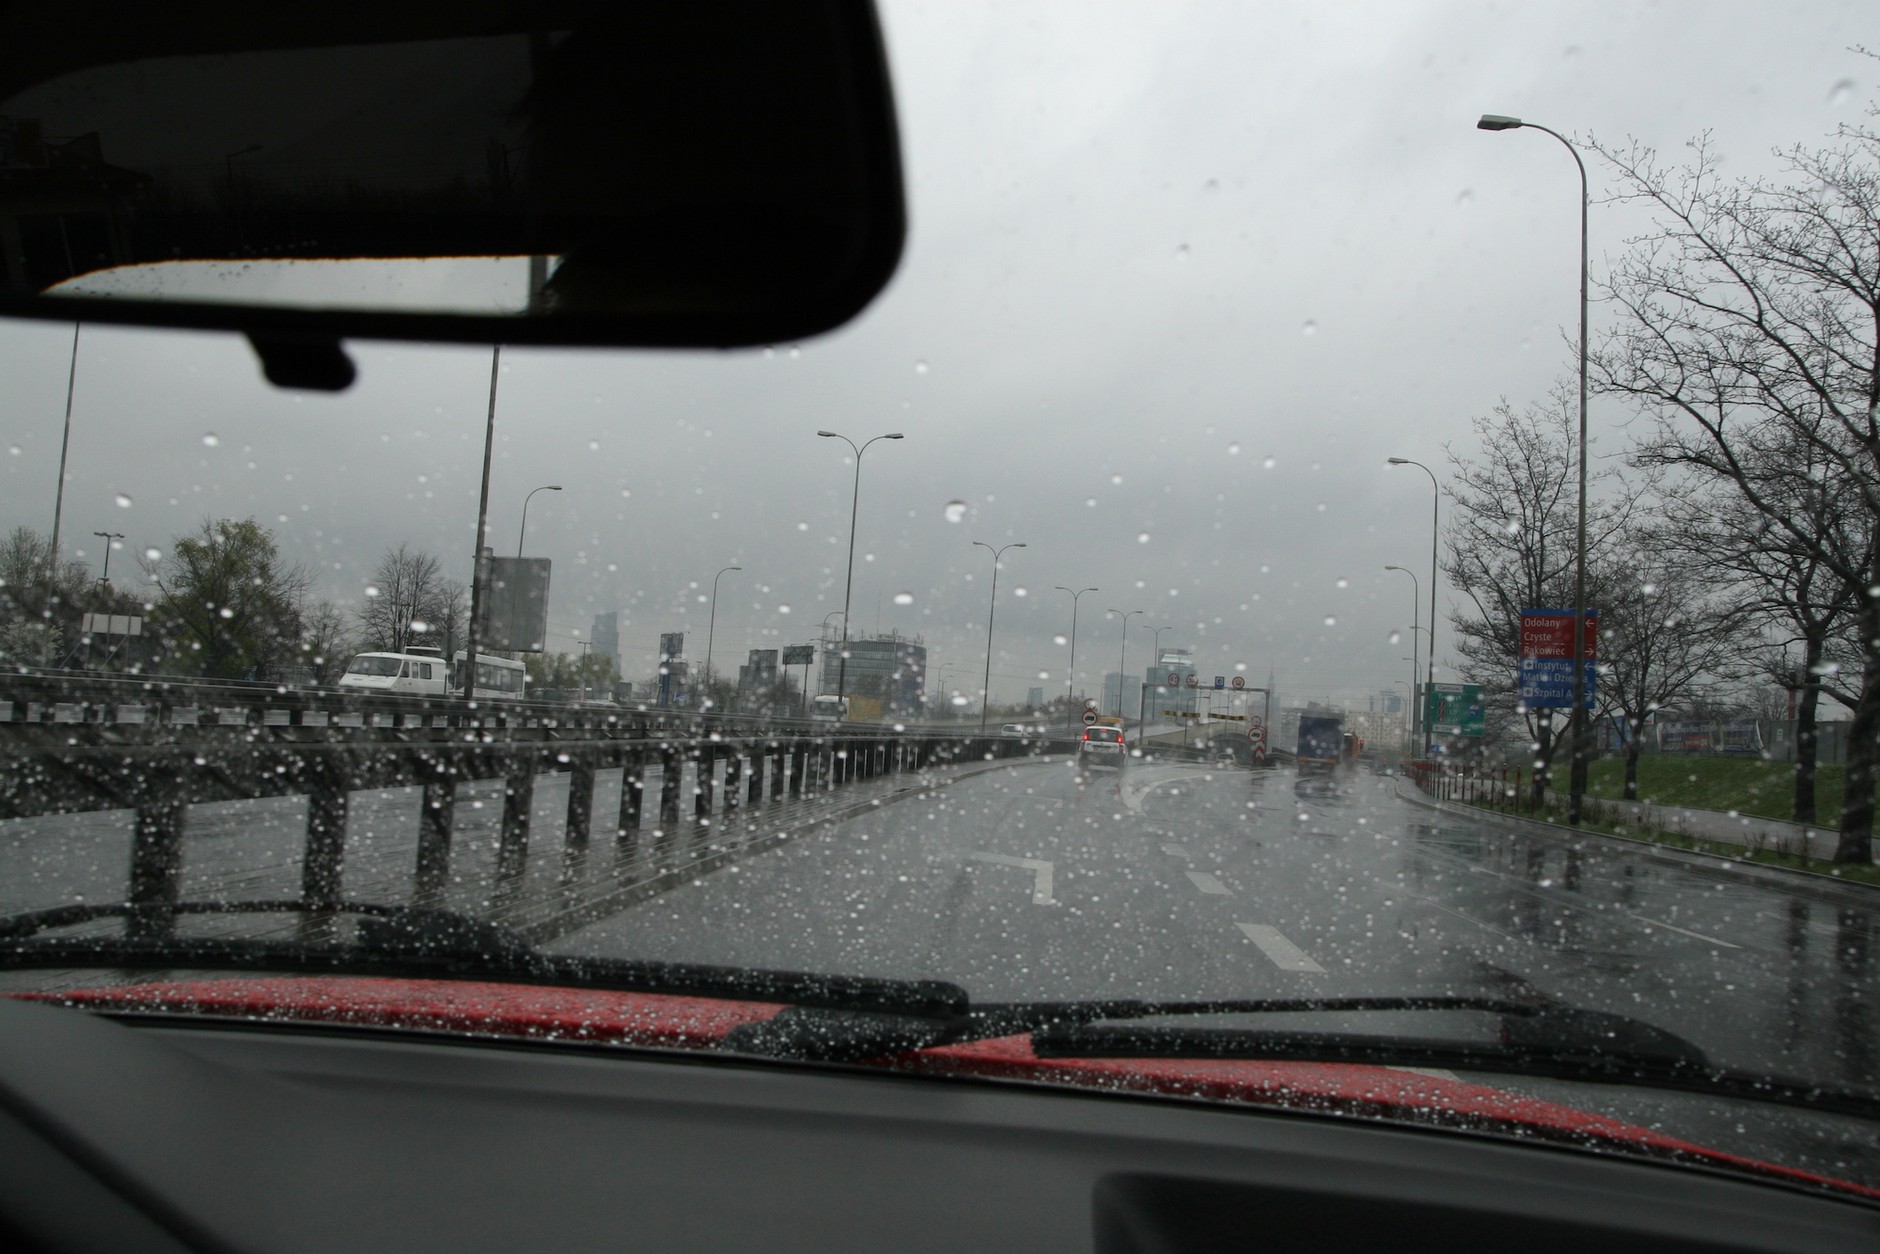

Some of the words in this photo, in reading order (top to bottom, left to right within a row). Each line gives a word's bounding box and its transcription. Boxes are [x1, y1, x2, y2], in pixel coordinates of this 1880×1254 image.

[1524, 618, 1561, 629] Odolany
[1524, 632, 1552, 643] Czyste
[1524, 646, 1565, 655] Rakowiec
[1535, 662, 1568, 671] Instytut
[1523, 673, 1547, 682] Matk
[1554, 673, 1588, 682] Dziea
[1534, 689, 1563, 699] Szpital
